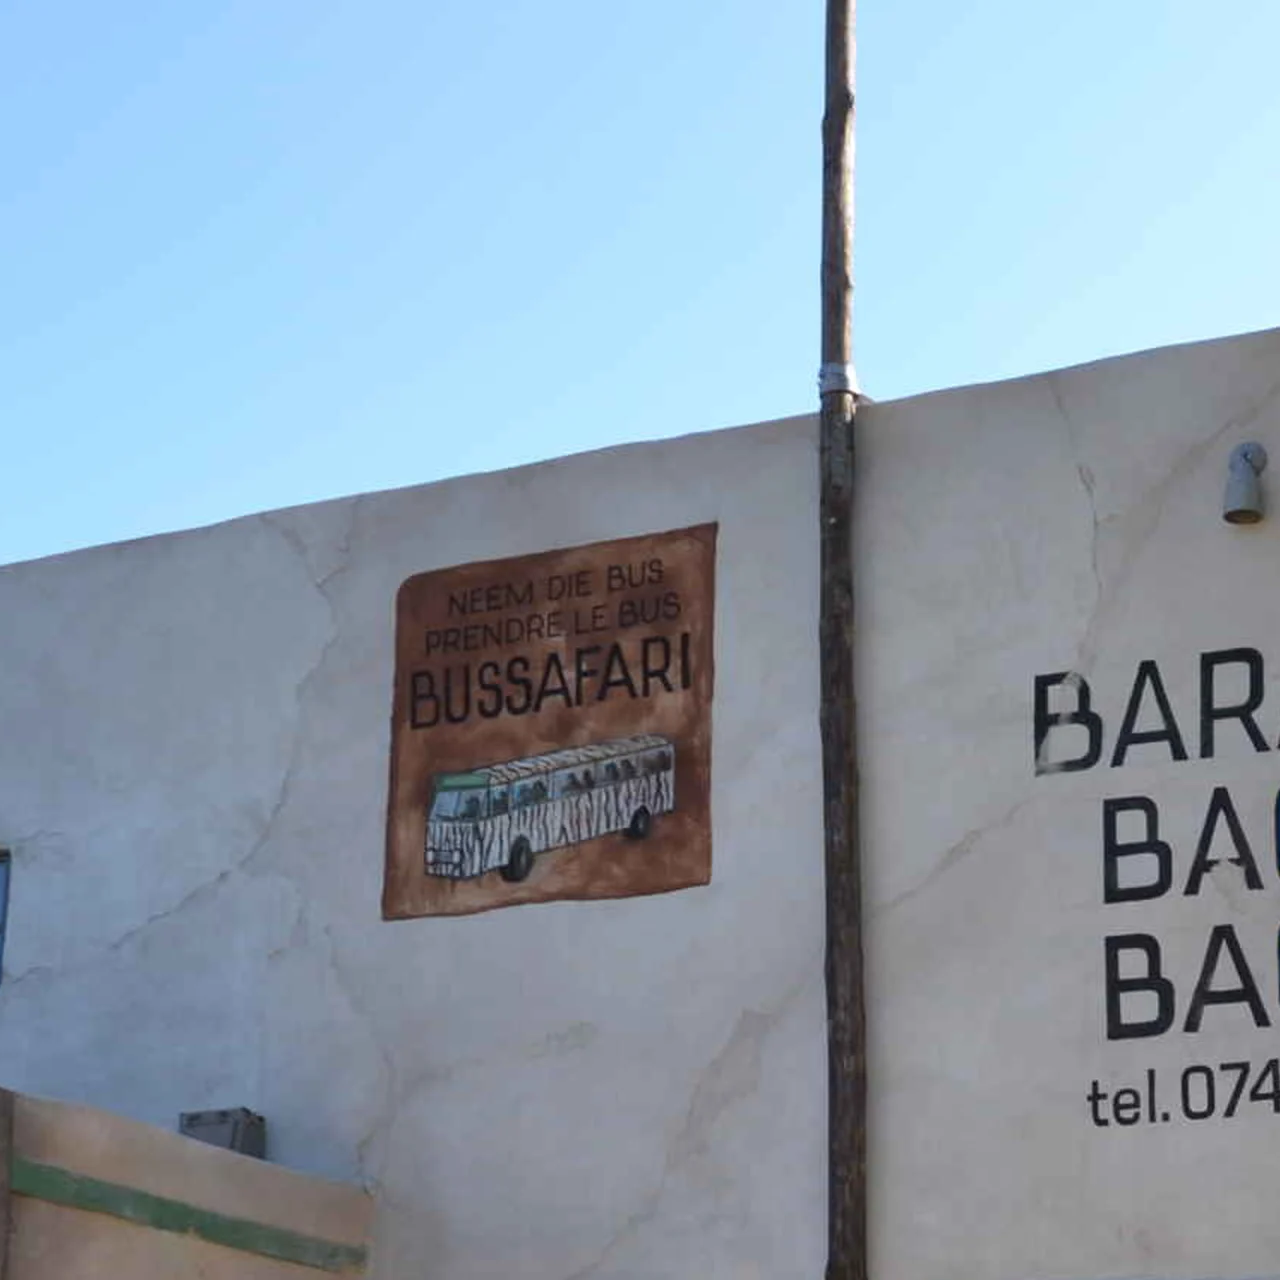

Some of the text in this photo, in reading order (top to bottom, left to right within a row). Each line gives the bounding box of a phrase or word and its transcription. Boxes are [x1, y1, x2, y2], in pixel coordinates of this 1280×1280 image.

[448, 559, 664, 617] NEEM DIE BUS
[425, 592, 682, 655] PRENDRE LE BUS
[409, 633, 692, 730] BUSSAFARI
